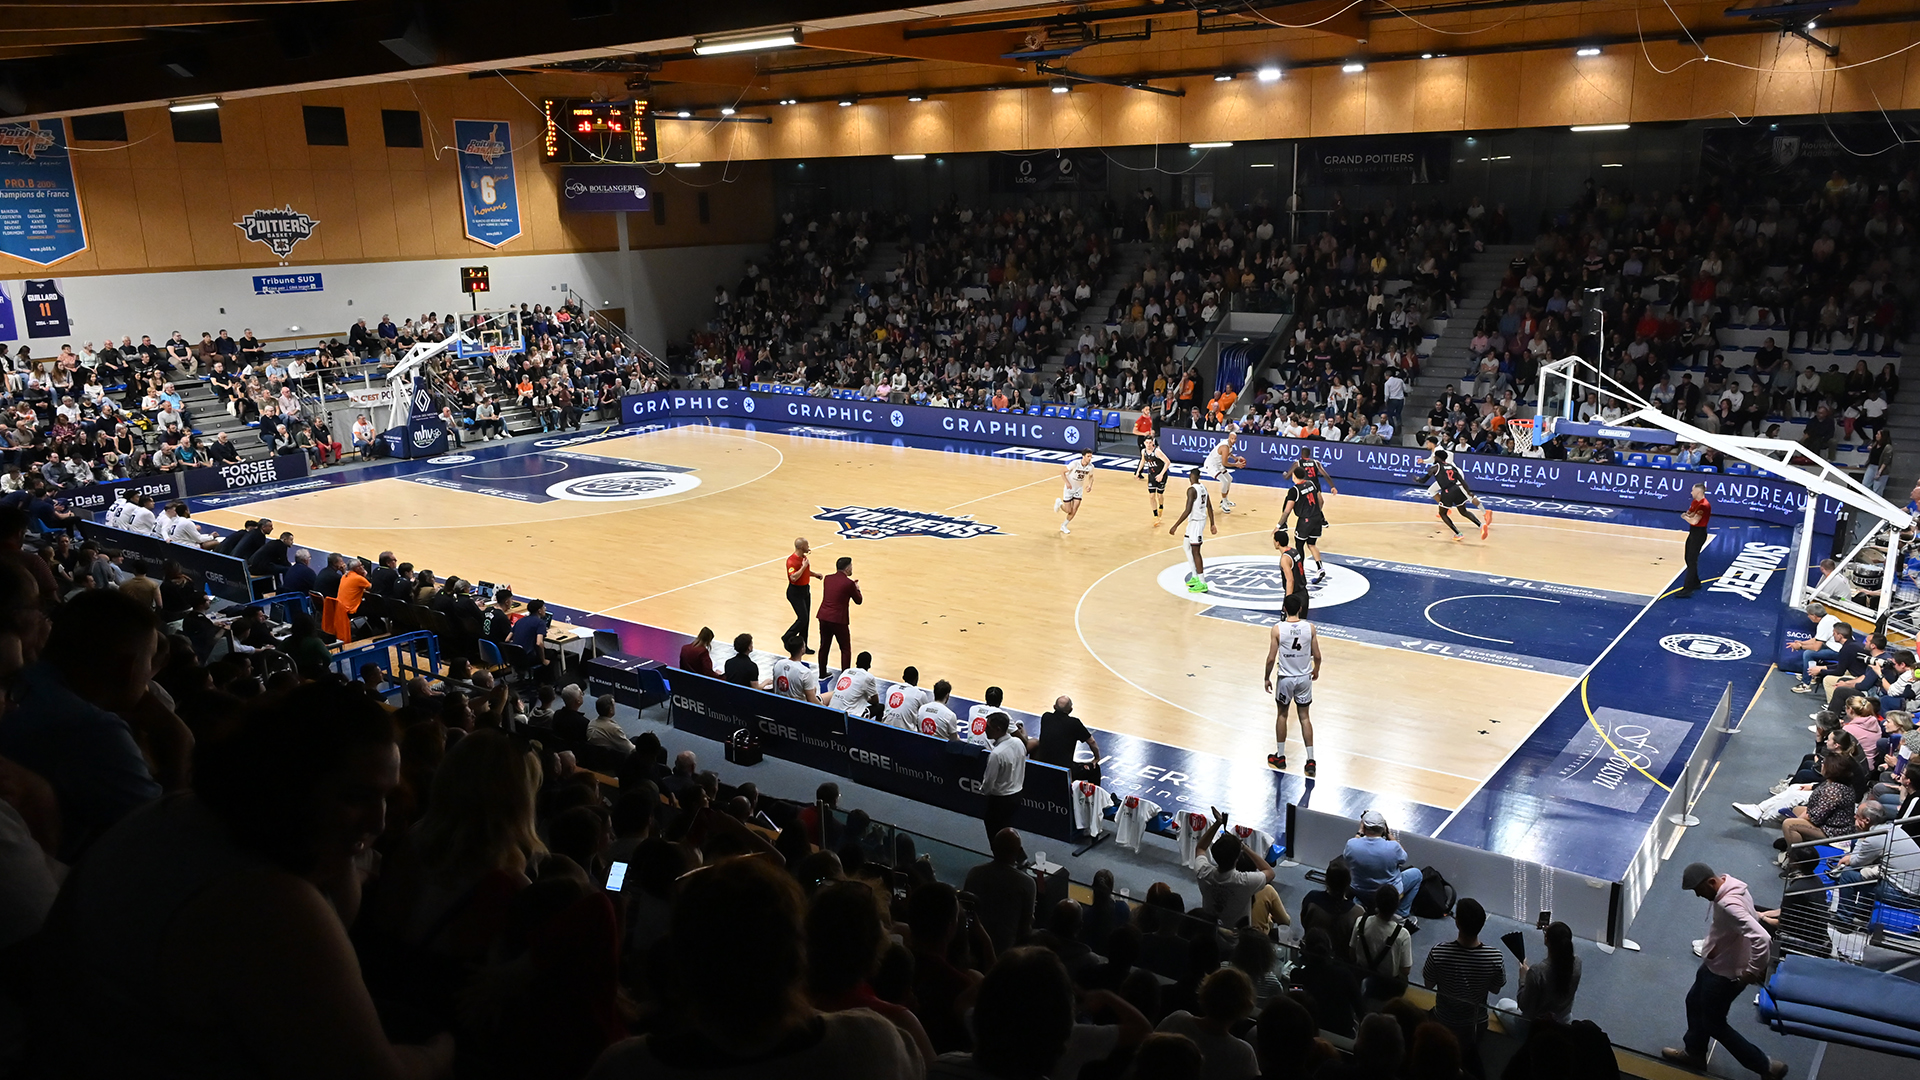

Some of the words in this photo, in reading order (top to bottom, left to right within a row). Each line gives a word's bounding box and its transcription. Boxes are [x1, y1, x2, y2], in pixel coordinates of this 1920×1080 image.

[1324, 154, 1363, 165] GRAND
[1365, 153, 1414, 164] POITIERS
[5, 178, 35, 189] PRO.B
[481, 174, 497, 205] 6
[0, 190, 35, 200] hampions
[36, 190, 46, 198] de
[47, 190, 70, 198] France
[473, 202, 508, 216] homme
[246, 216, 310, 236] POITIERS
[261, 276, 296, 286] Tribune
[297, 275, 315, 284] SUD
[27, 293, 59, 302] GUILLARD
[39, 302, 52, 317] 11
[633, 396, 729, 415] GRAPHIC
[788, 402, 873, 424] GRAPHIC
[943, 416, 1043, 440] GRAPHIC
[1462, 459, 1560, 480] LANDREAU
[226, 470, 277, 489] POWER
[1577, 469, 1684, 492] LANDREAU
[143, 483, 171, 496] Data
[1703, 480, 1808, 508] LANDREAU
[75, 494, 105, 507] Data
[822, 506, 994, 539] POITIERS
[204, 570, 226, 585] CBRE
[1508, 579, 1538, 589] FL
[1291, 637, 1302, 651] 4
[1421, 643, 1455, 656] FL
[672, 694, 706, 715] CBRE
[707, 707, 731, 723] Immo
[732, 715, 748, 727] Pro
[758, 720, 799, 741] CBRE
[801, 733, 829, 749] Immo
[830, 740, 848, 754] Pro
[849, 747, 892, 771] CBRE
[894, 762, 924, 779] Immo
[926, 771, 944, 785] Pro
[958, 776, 984, 794] CB
[1048, 800, 1068, 816] Pro
[1101, 774, 1190, 802] rbaine
